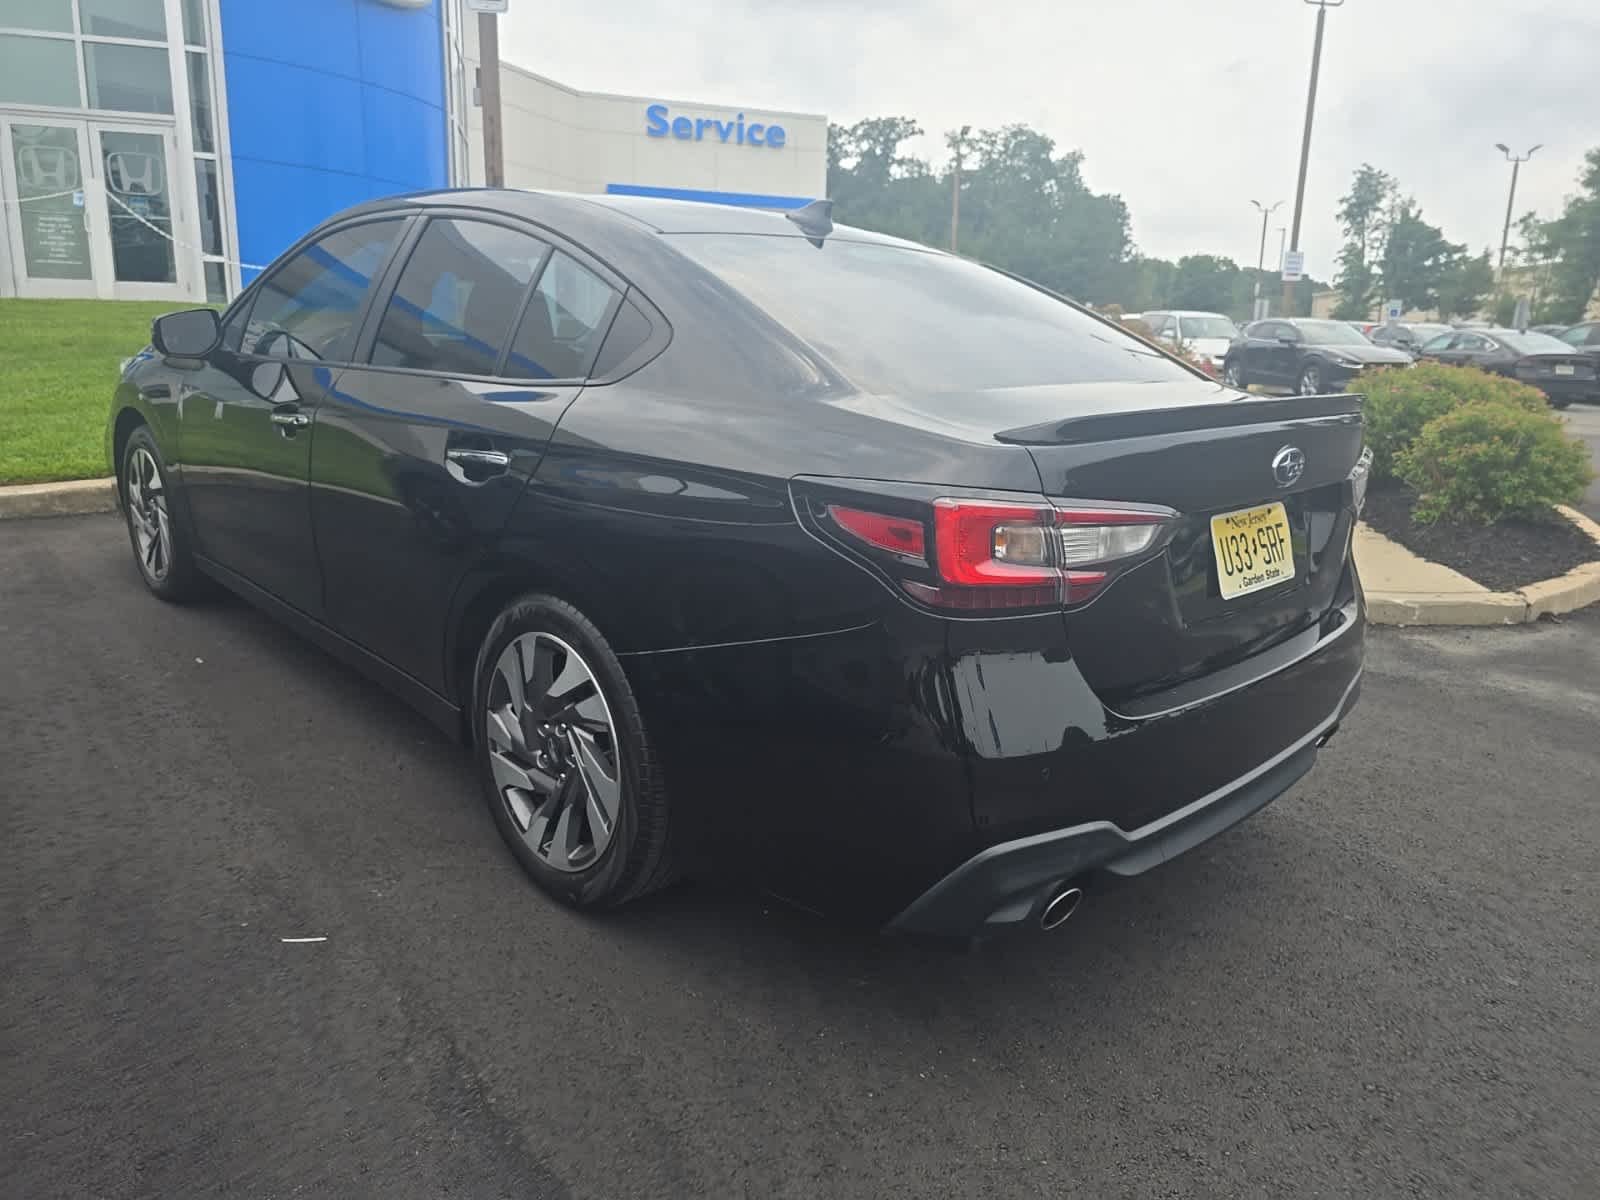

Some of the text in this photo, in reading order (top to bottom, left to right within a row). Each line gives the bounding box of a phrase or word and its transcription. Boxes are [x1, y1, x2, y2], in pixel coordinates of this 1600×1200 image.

[646, 104, 786, 149] Service
[1230, 512, 1267, 529] New Jersey
[1243, 568, 1280, 587] Garden State
